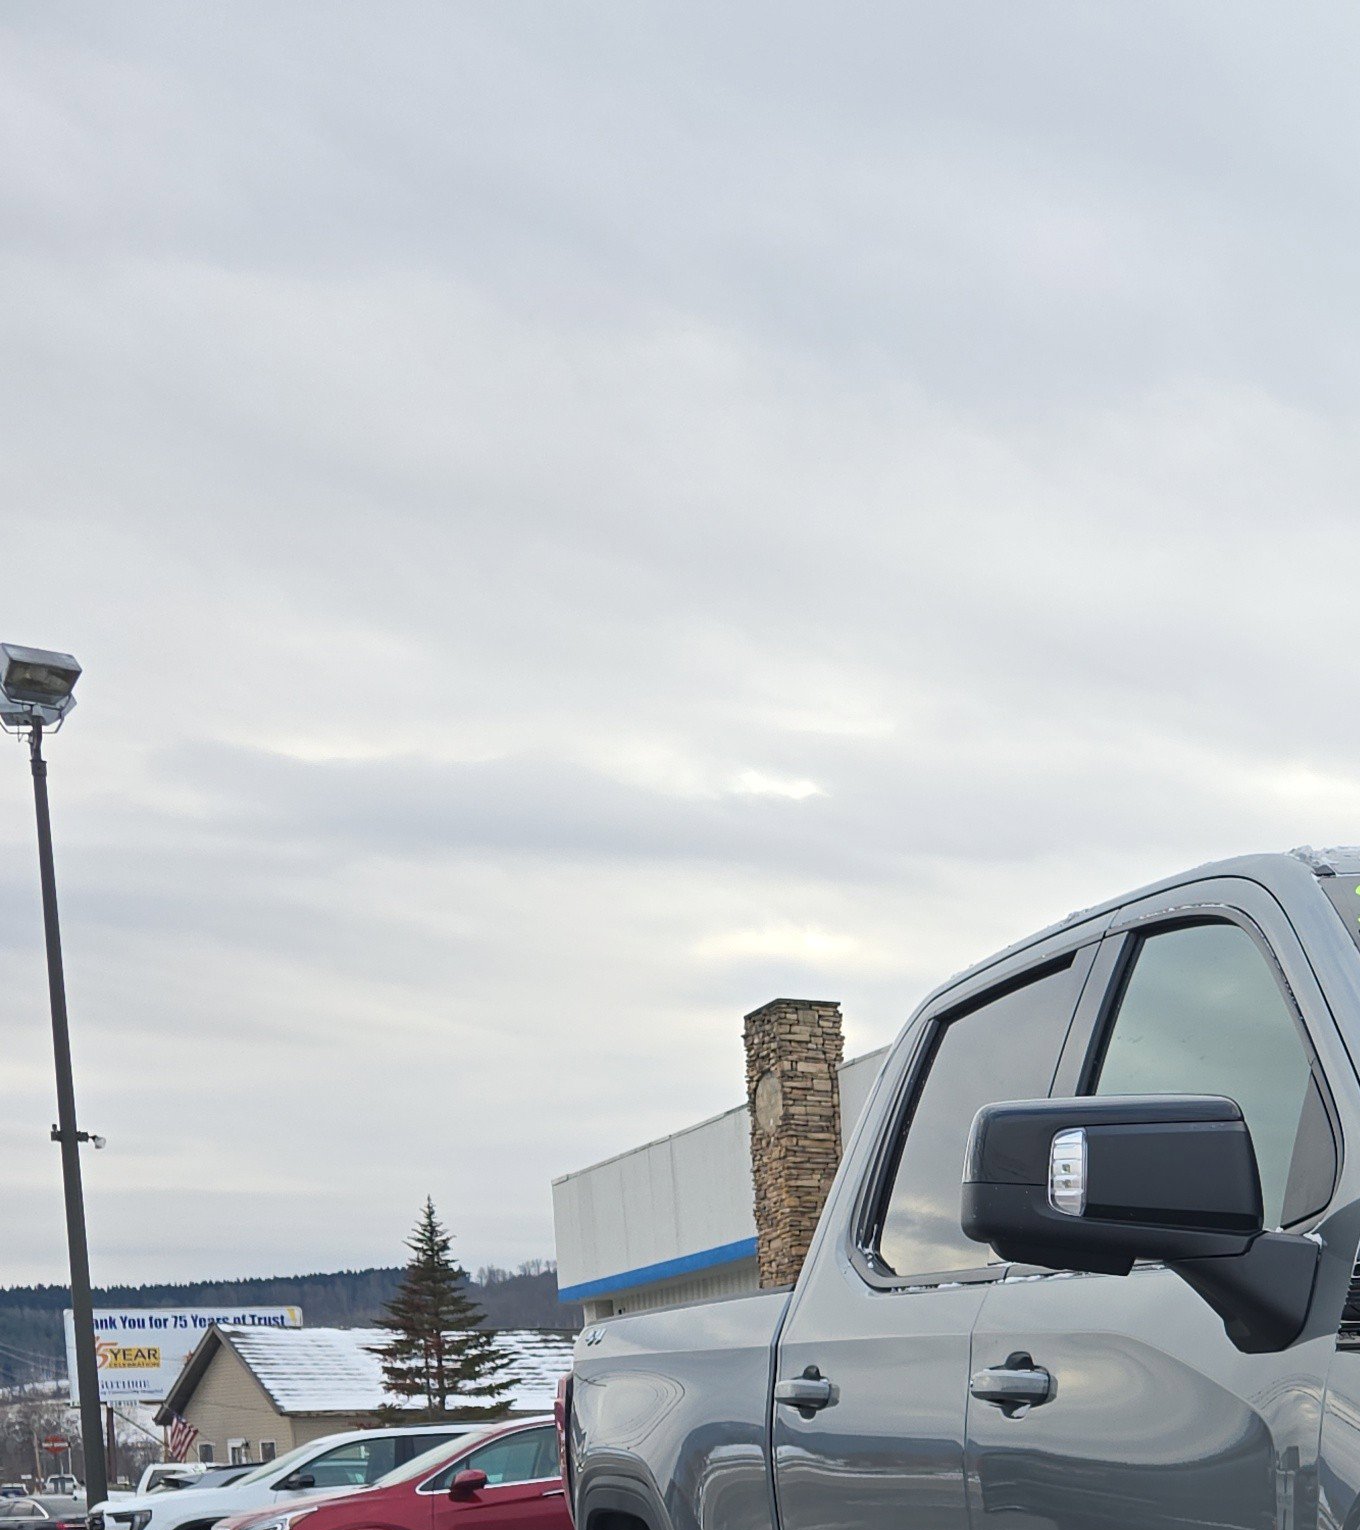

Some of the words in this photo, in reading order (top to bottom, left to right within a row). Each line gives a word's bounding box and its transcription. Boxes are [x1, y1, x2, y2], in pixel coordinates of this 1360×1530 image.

[93, 1315, 117, 1330] ank
[120, 1315, 145, 1330] You
[149, 1315, 169, 1329] for
[171, 1315, 188, 1329] 75
[191, 1314, 230, 1329] Years
[249, 1314, 285, 1327] Trust
[95, 1336, 118, 1368] 5
[109, 1348, 158, 1361] YEAR
